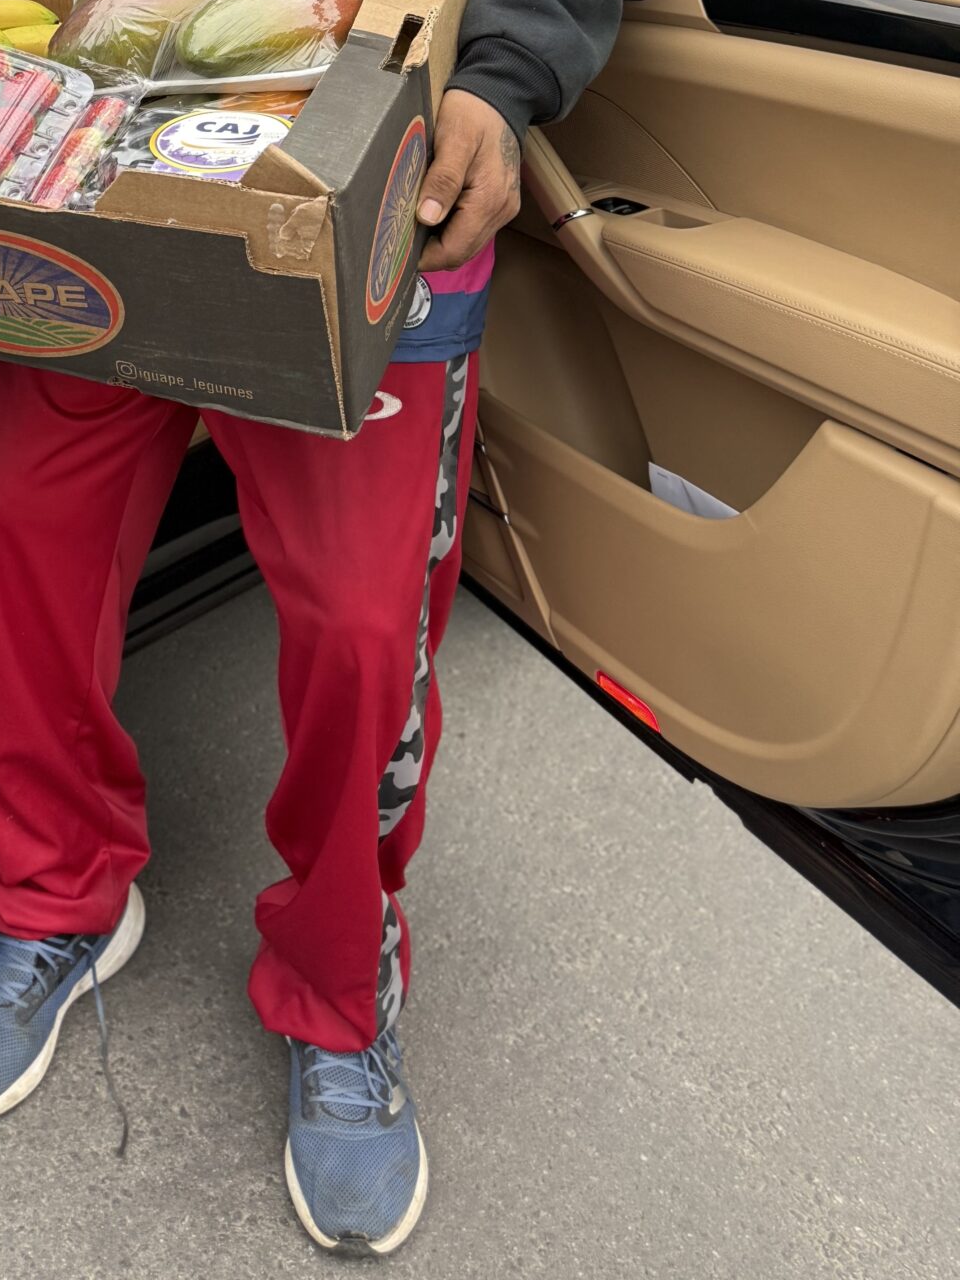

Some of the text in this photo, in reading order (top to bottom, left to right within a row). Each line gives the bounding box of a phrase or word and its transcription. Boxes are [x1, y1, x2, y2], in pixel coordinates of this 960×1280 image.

[195, 121, 261, 135] CAJ
[375, 140, 421, 297] IGUAPE
[139, 368, 255, 400] iguape_legumes
